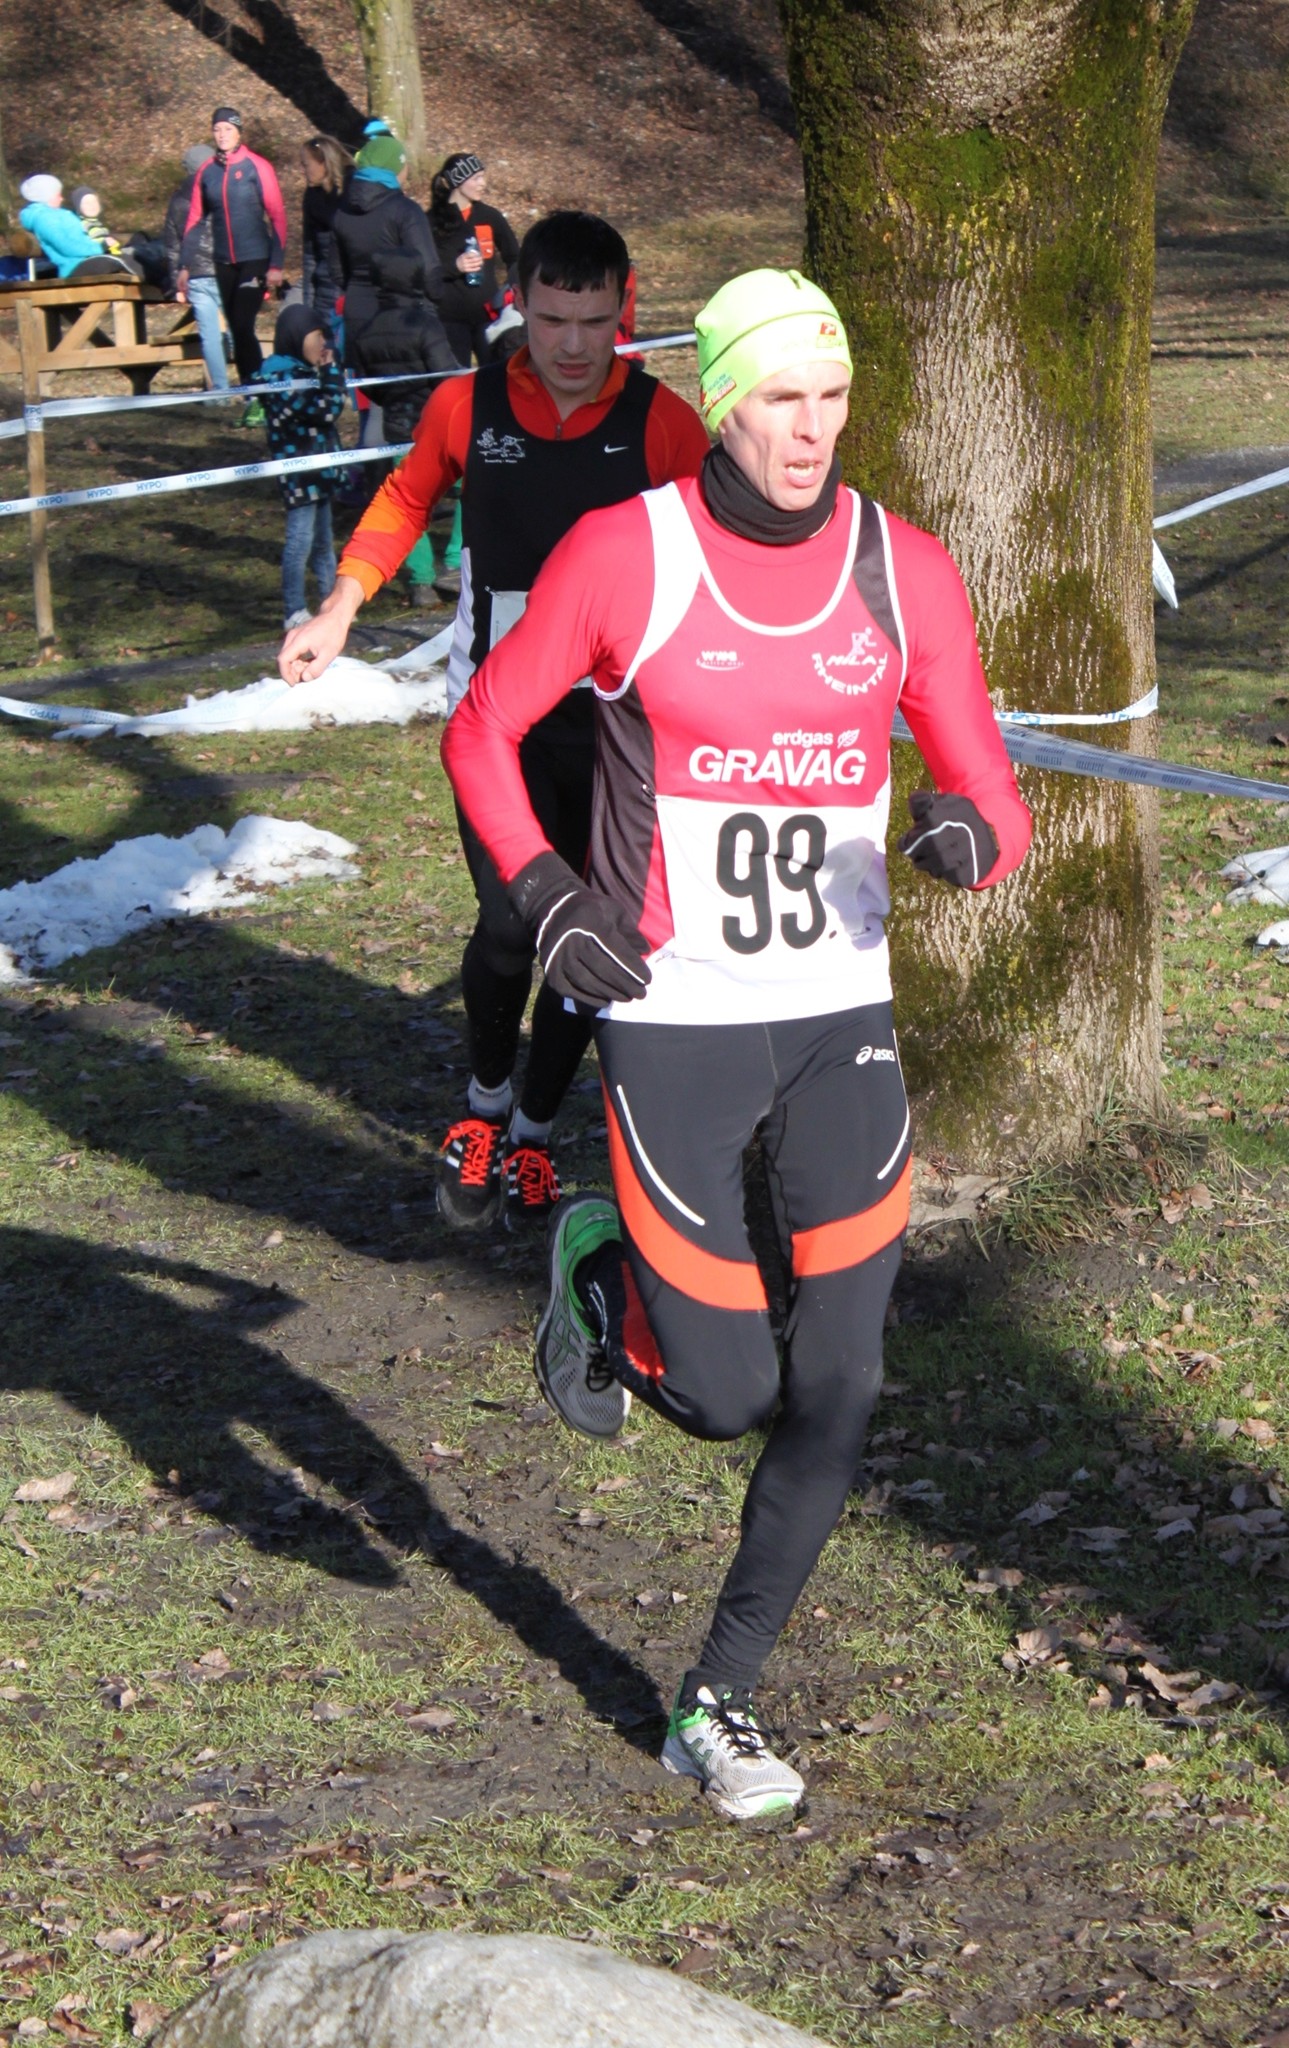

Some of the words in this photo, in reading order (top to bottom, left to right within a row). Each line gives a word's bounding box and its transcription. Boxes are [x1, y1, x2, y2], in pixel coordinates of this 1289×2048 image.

[37, 495, 63, 507] HYPO
[87, 487, 113, 499] HYPO
[136, 480, 162, 492] HYPO
[186, 472, 211, 484] HYPO
[234, 464, 260, 477] HYPO
[282, 457, 308, 469] HYPO
[772, 729, 834, 748] erdgas
[688, 745, 867, 787] GRAVAG
[716, 811, 827, 955] 99
